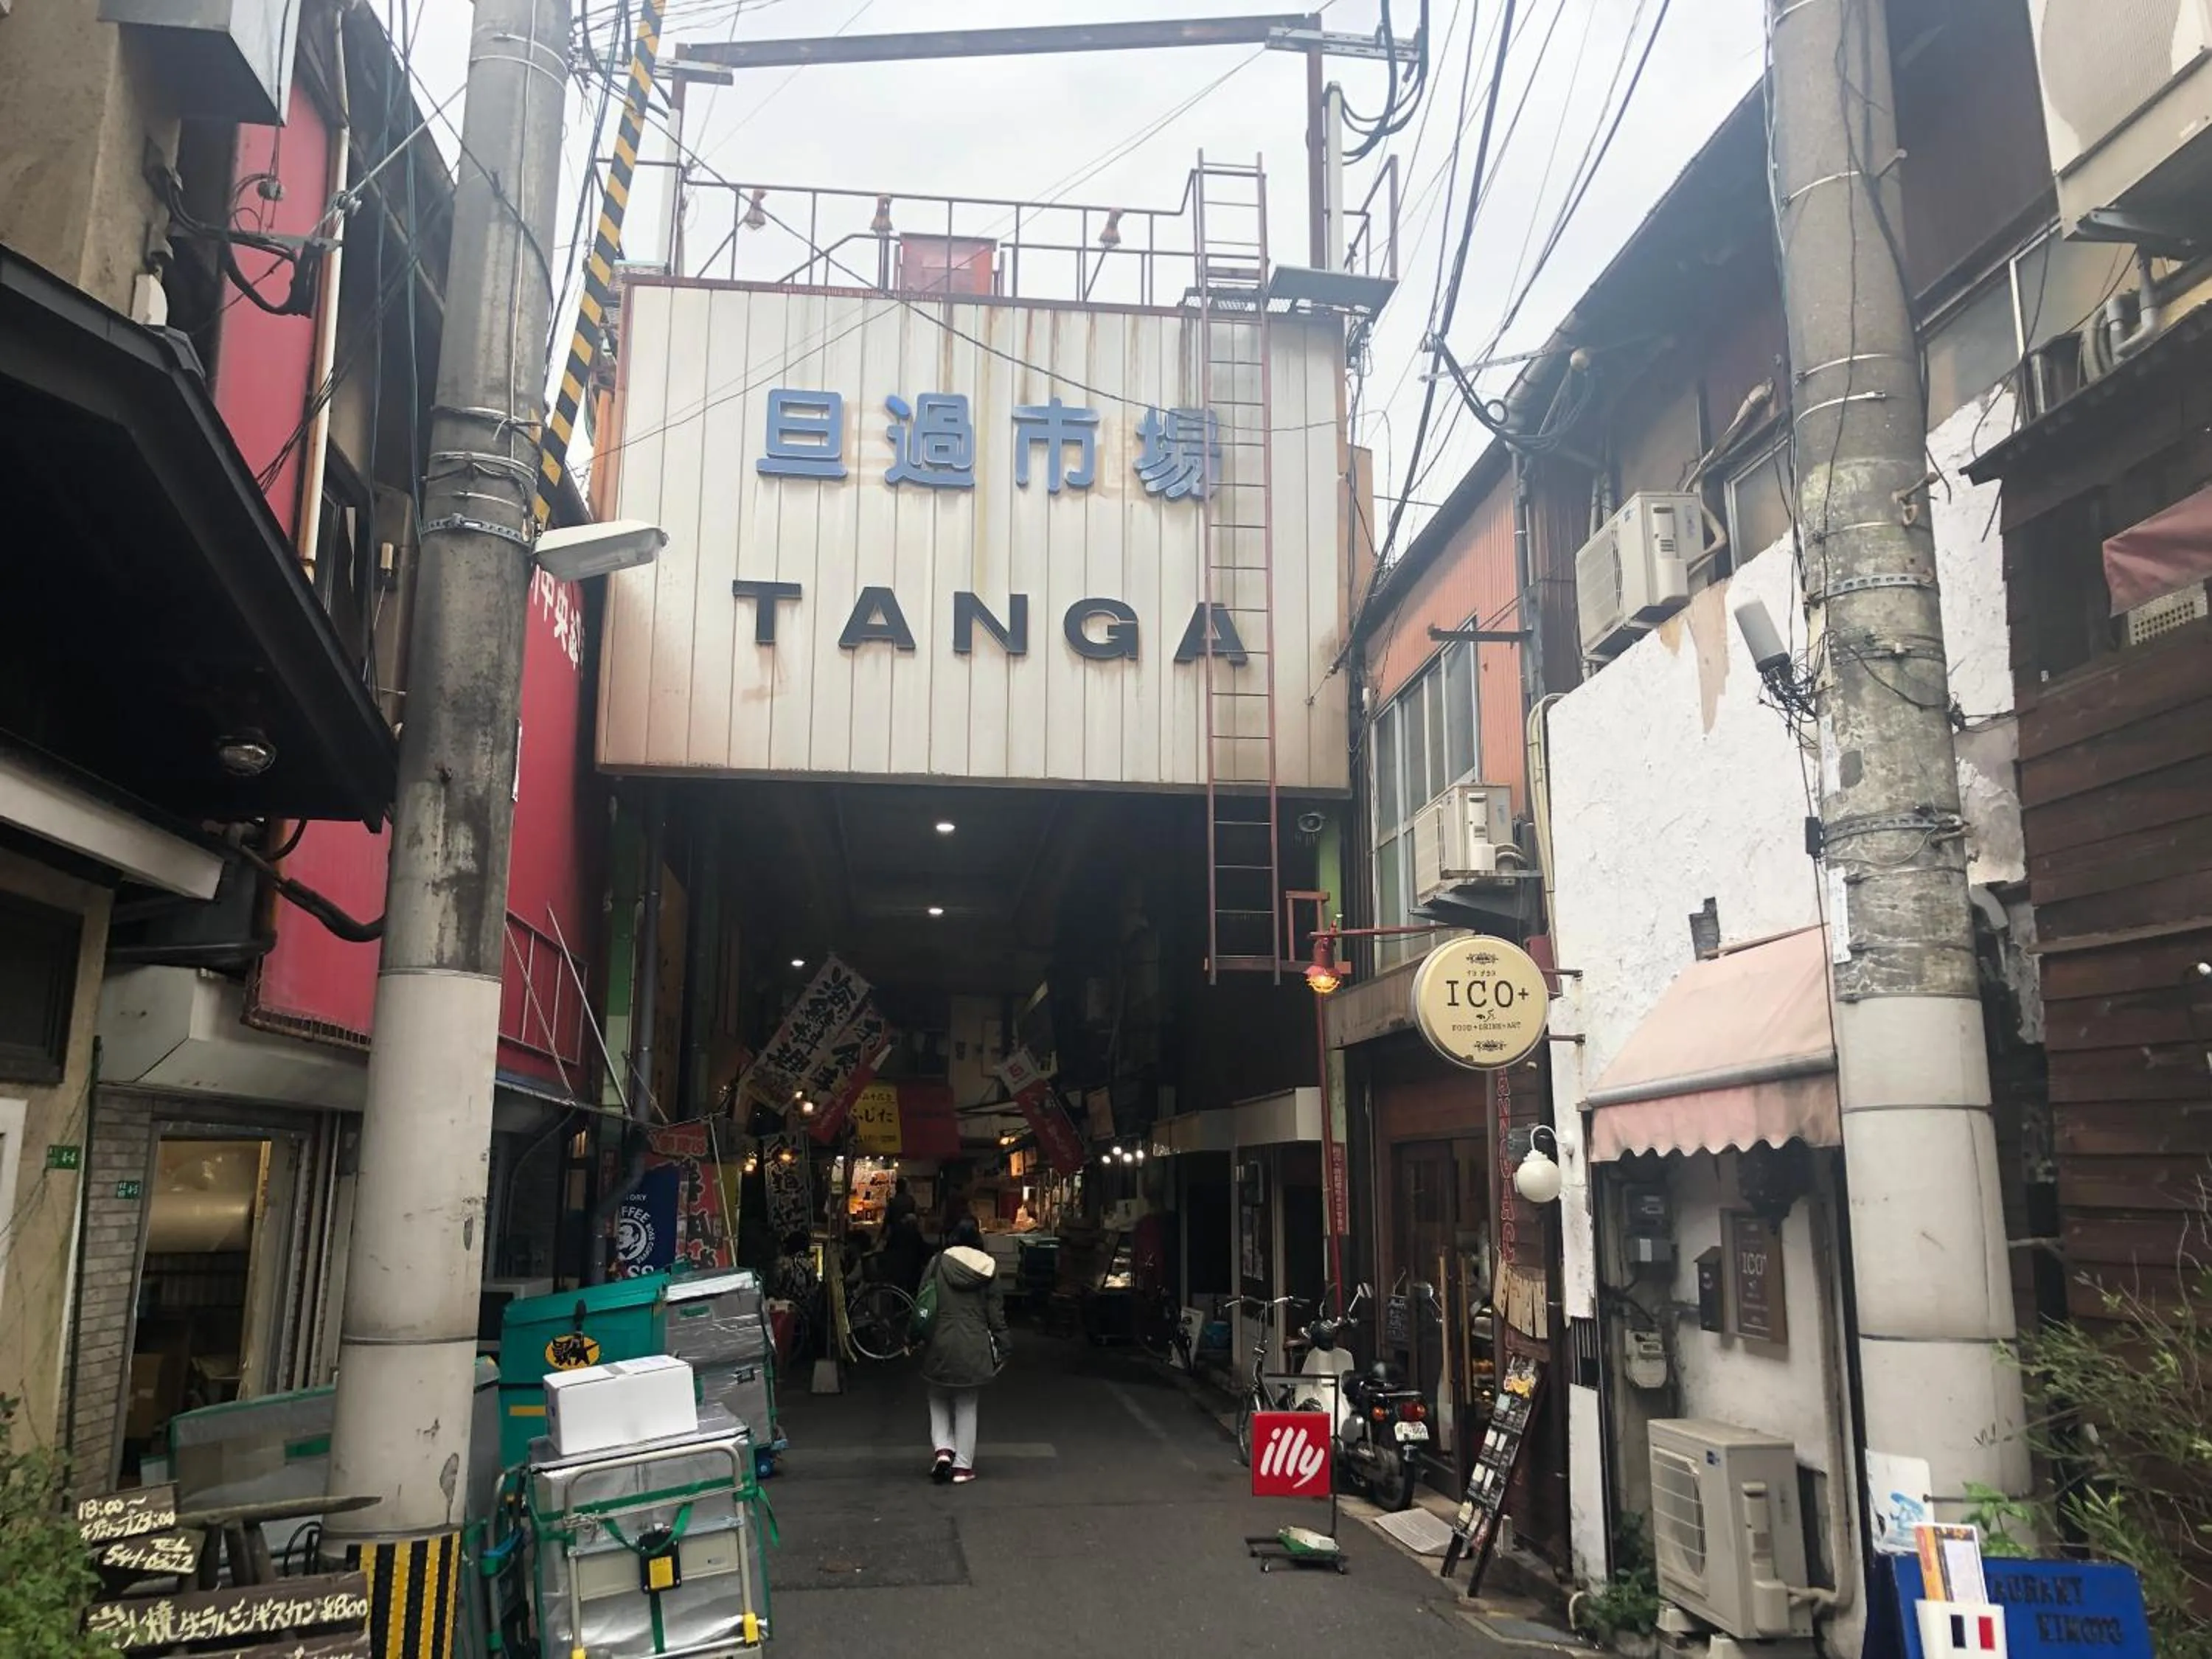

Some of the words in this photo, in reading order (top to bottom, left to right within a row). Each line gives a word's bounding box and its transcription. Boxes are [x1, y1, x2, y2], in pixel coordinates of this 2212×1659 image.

[756, 387, 1222, 501] 旦過市場
[732, 580, 1249, 664] TANGA
[1445, 980, 1529, 1008] ICO+
[1260, 1426, 1325, 1489] illy
